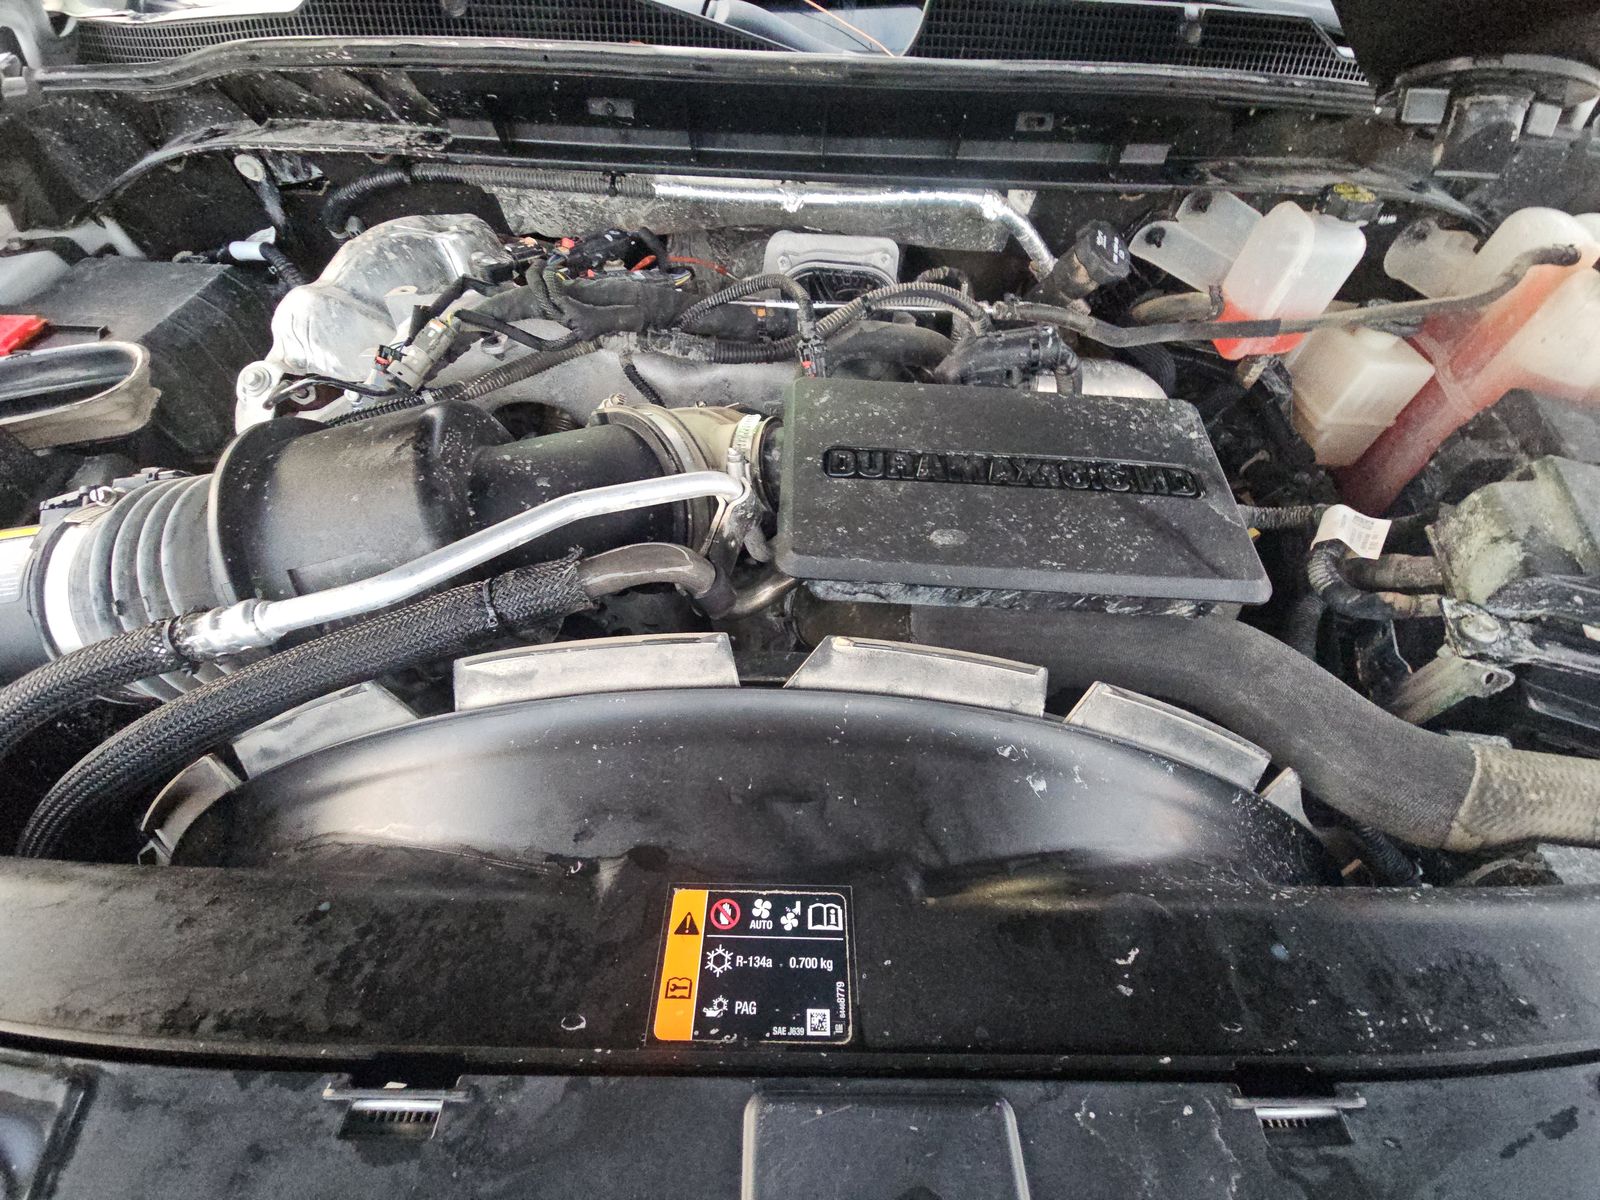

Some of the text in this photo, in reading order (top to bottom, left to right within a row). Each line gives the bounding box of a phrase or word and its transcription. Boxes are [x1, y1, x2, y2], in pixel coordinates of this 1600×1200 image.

[828, 448, 1059, 484] DURAMAX
[749, 919, 773, 930] AUTO
[735, 955, 833, 971] R-134a 0.700 kg
[734, 1001, 757, 1015] PAG
[772, 1026, 805, 1036] SAE J639
